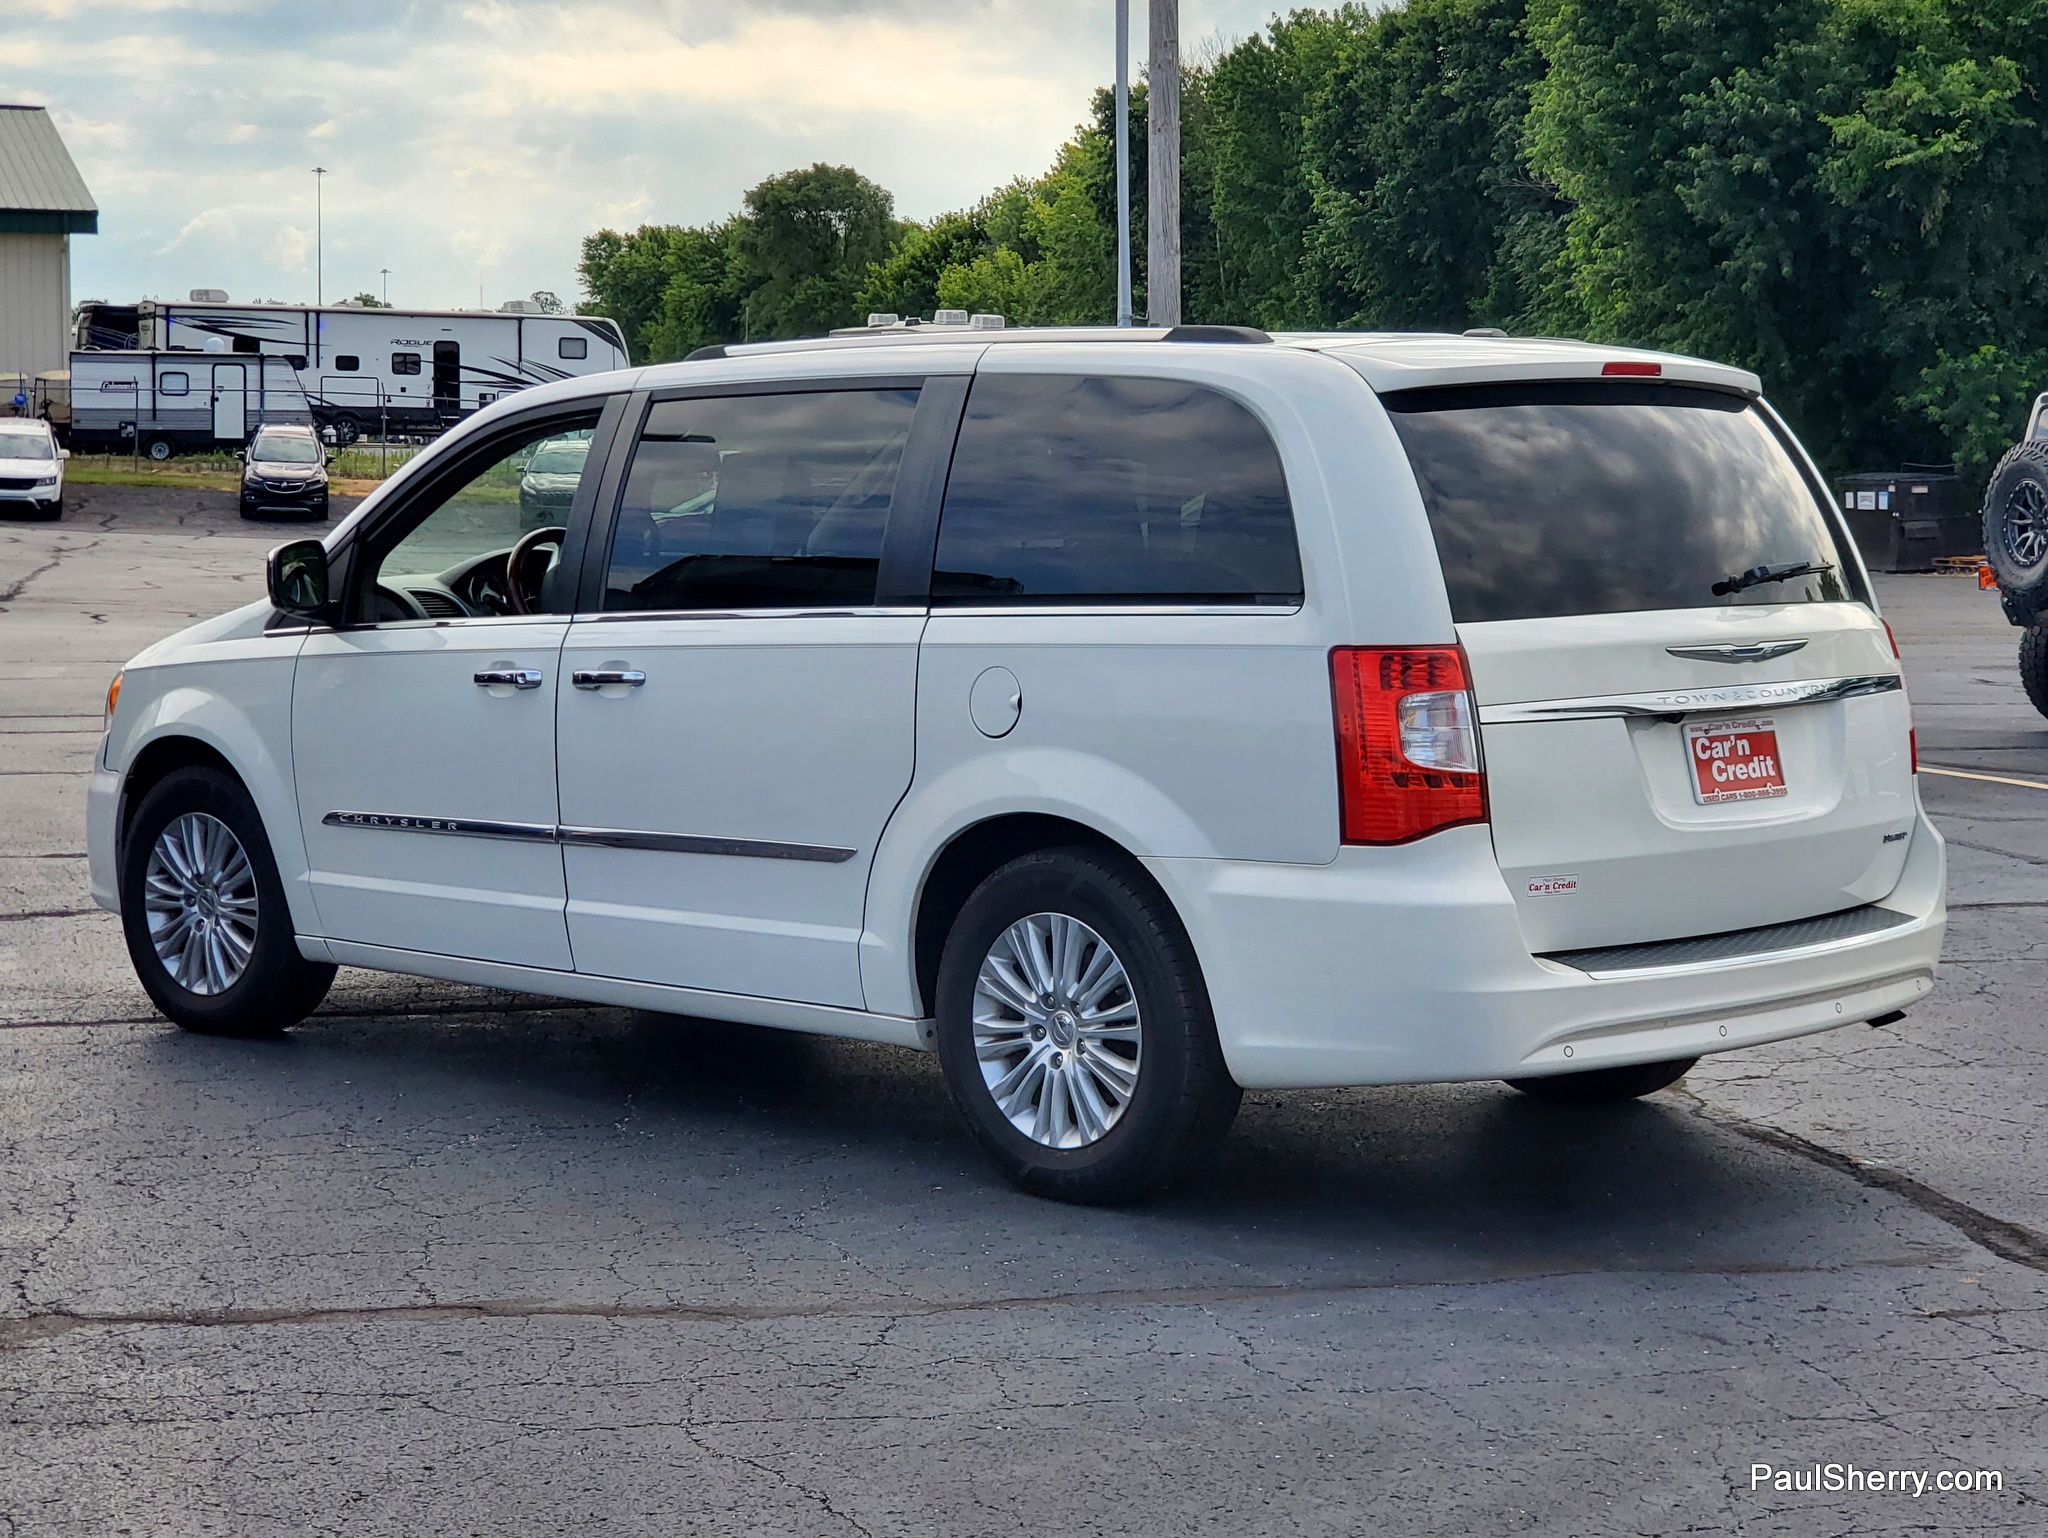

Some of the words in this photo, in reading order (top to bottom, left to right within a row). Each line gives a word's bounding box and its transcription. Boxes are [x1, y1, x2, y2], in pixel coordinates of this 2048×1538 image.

[1657, 692, 1726, 705] TOWN
[1746, 683, 1829, 700] COUNTRY
[1695, 735, 1751, 760] Car'n
[1711, 755, 1776, 782] Credit
[1703, 794, 1720, 803] USED
[1721, 792, 1738, 801] CARS
[338, 813, 458, 831] CHRYSLER
[1528, 882, 1550, 892] Car'n
[1552, 880, 1577, 890] Credit
